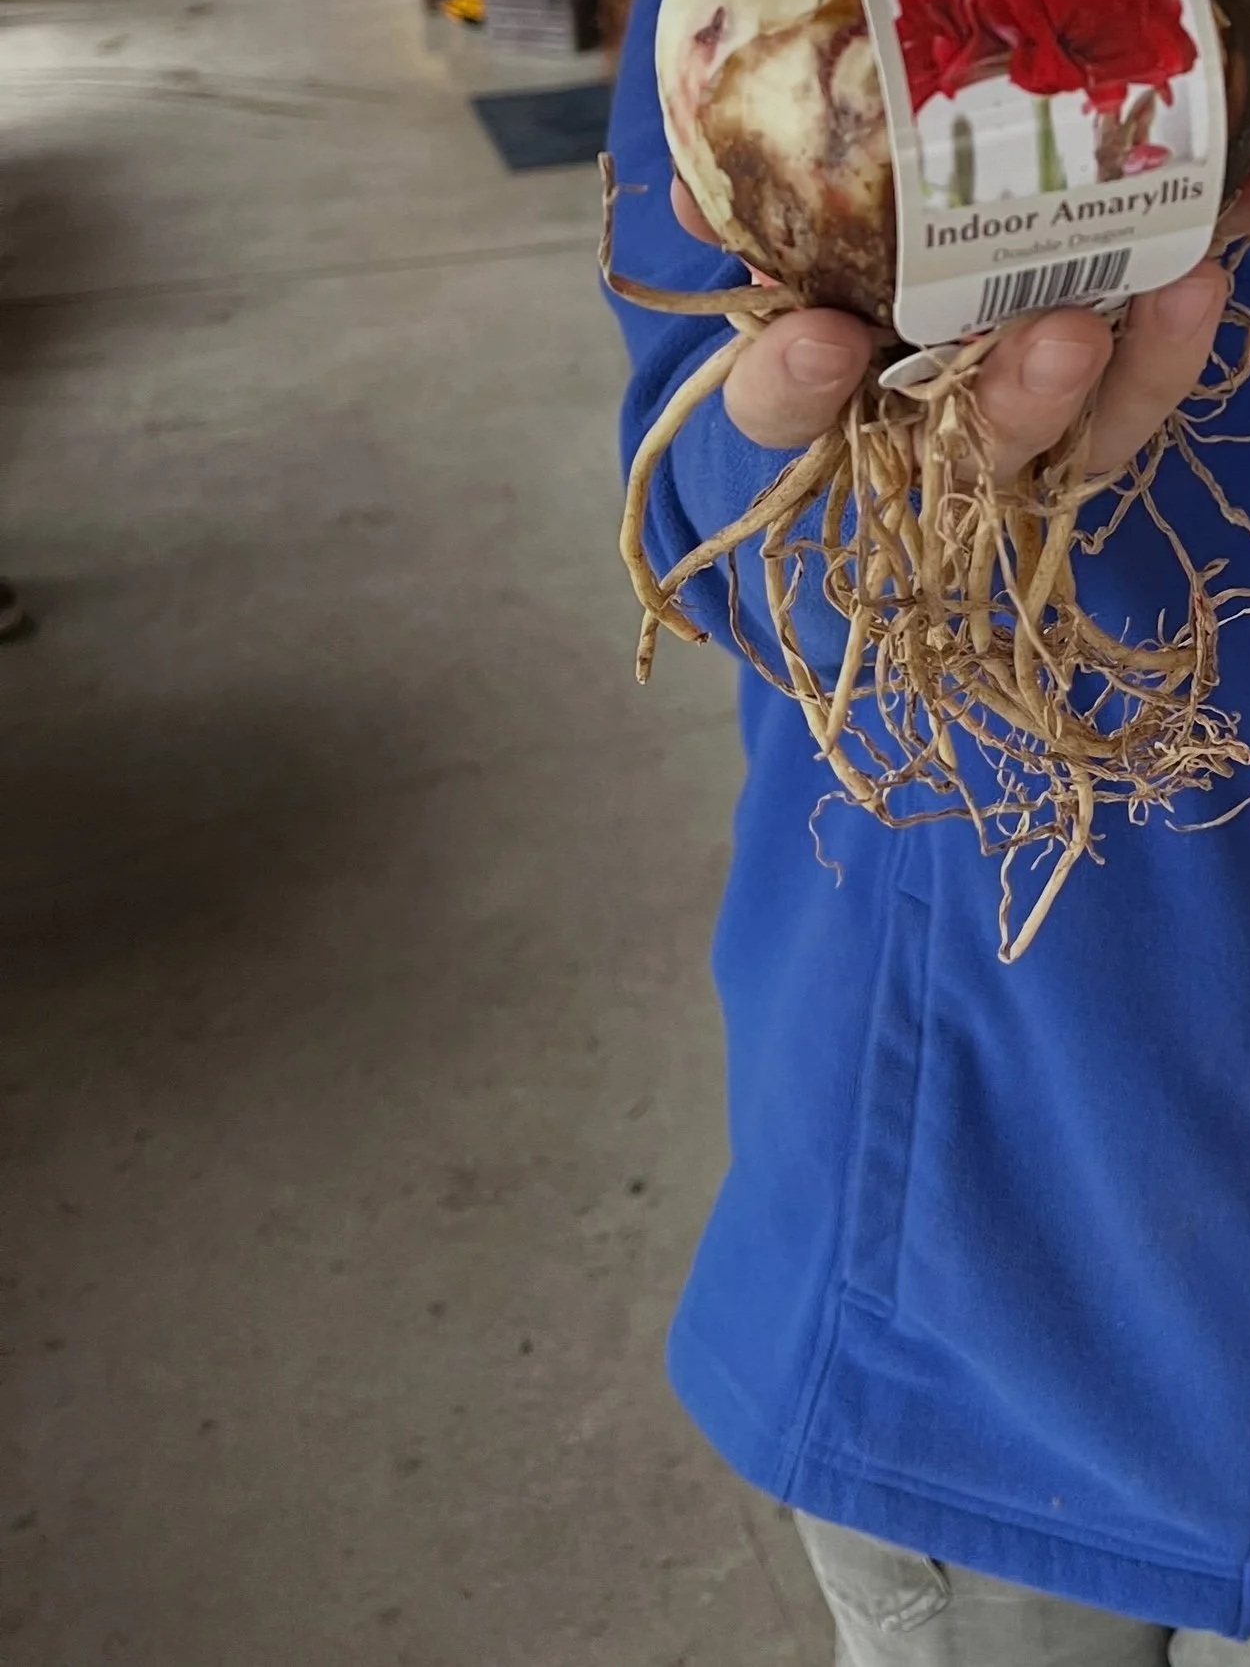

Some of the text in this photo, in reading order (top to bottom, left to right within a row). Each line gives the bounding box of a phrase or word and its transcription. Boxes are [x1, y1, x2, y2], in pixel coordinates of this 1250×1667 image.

[925, 176, 1205, 249] Indoor Amaryllis
[992, 238, 1063, 263] Double
